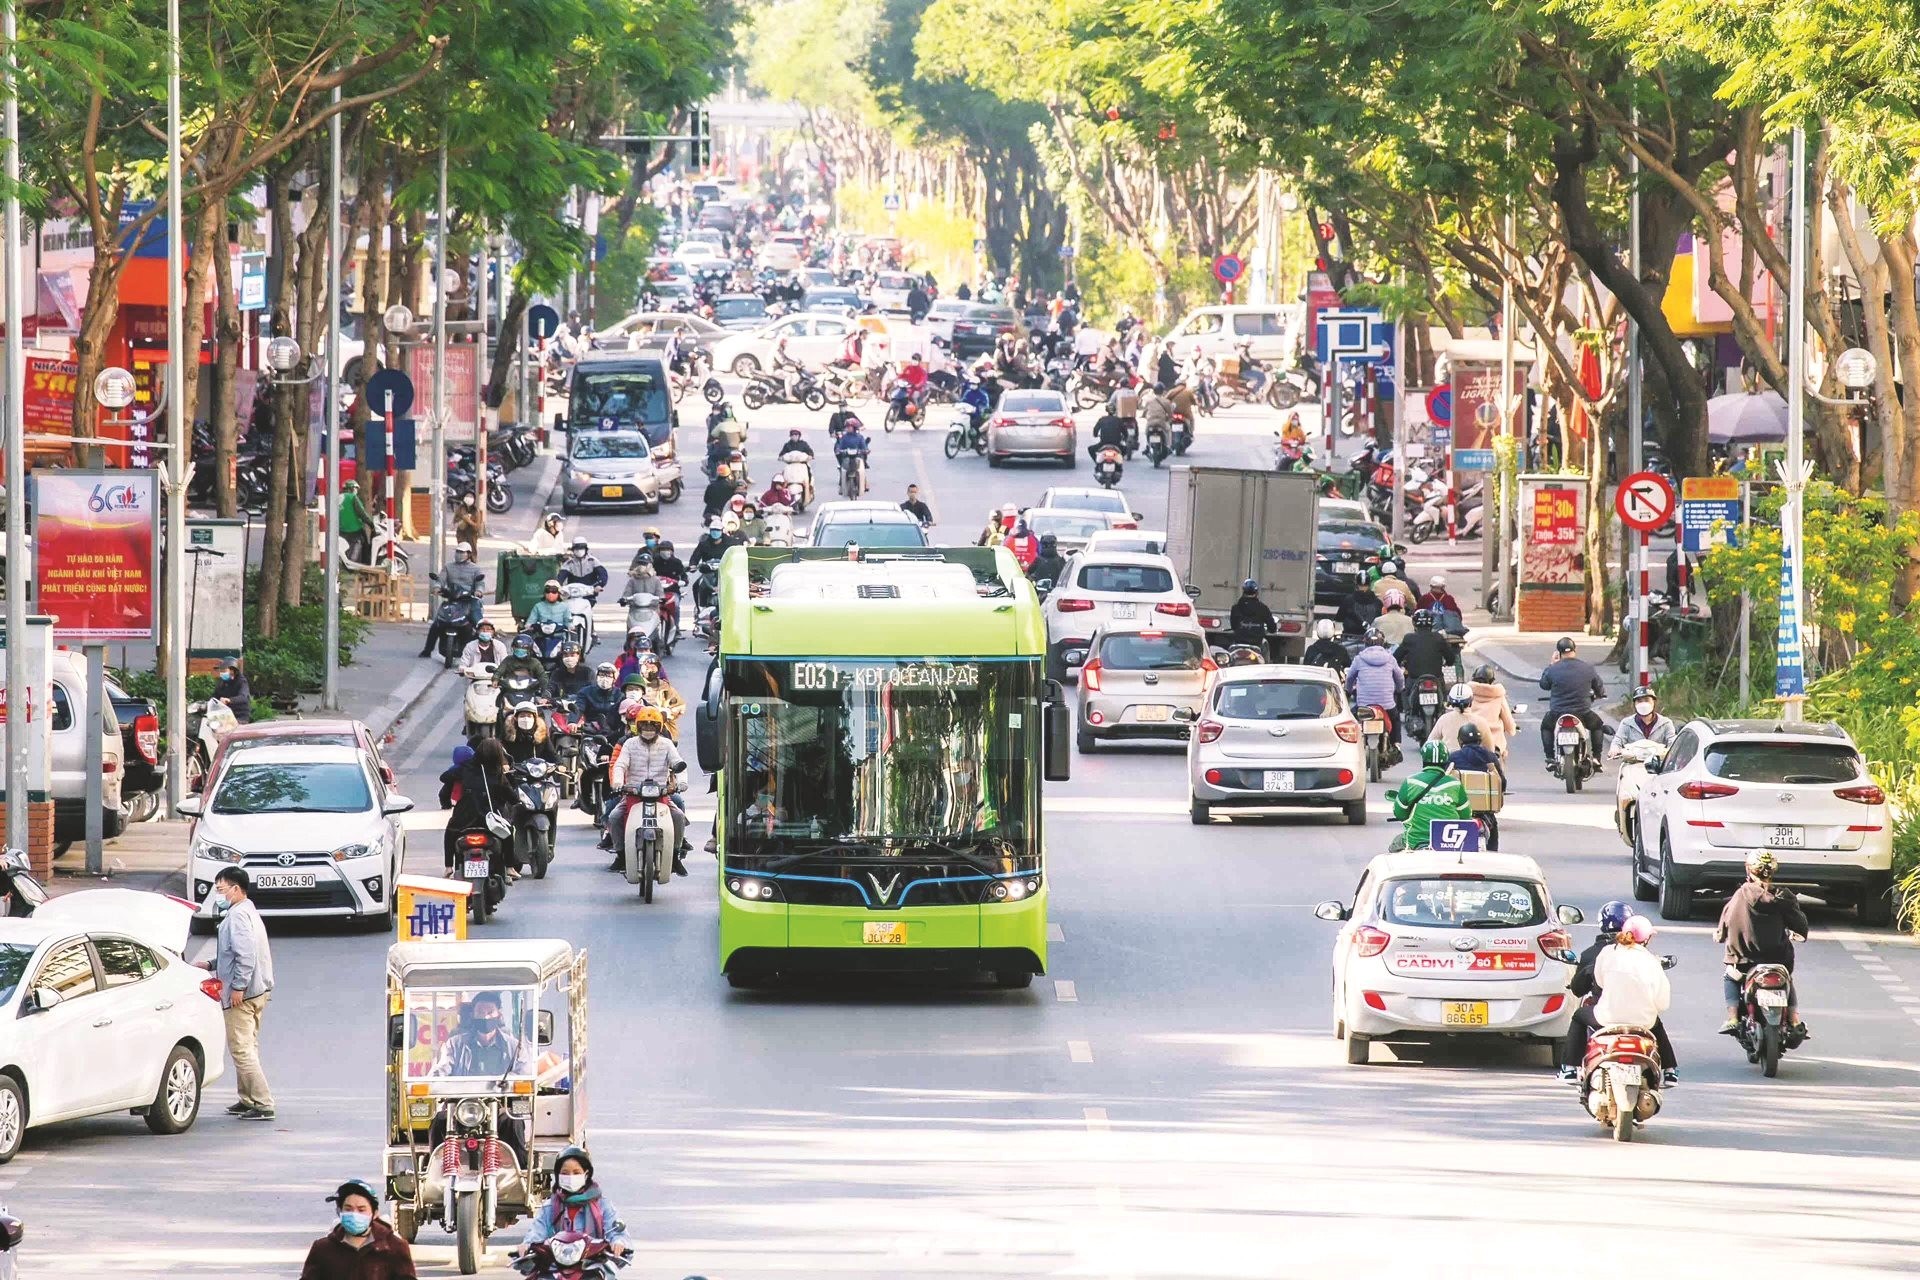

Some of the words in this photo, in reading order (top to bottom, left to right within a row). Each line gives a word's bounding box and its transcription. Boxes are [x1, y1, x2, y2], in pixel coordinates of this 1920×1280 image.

[124, 569, 142, 578] NAM
[794, 663, 827, 689] E03
[888, 667, 943, 686] OCEAN
[1441, 823, 1468, 849] G7
[1775, 827, 1793, 836] 30H
[1769, 837, 1800, 846] 121.04
[259, 875, 314, 887] 30A-284.90
[1492, 891, 1509, 901] 32
[1397, 959, 1454, 968] CADIVI
[1493, 954, 1504, 970] 1
[1454, 1003, 1475, 1013] 30A
